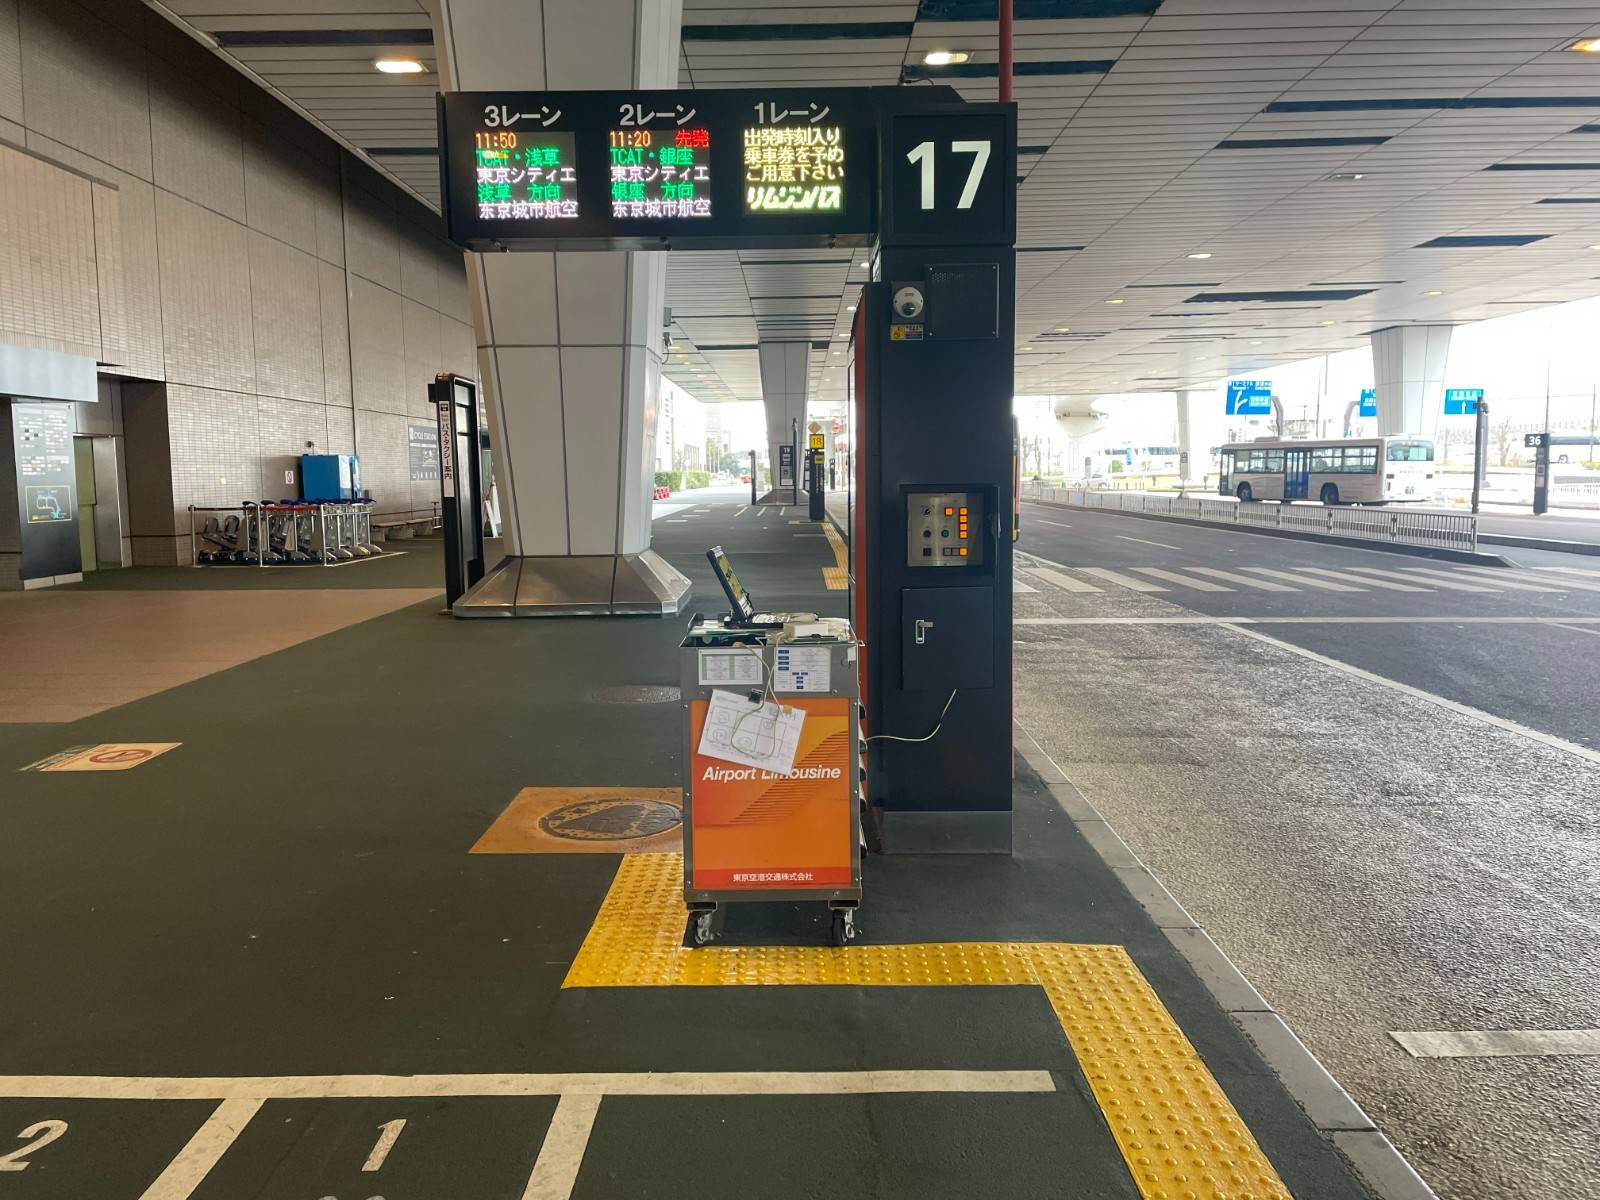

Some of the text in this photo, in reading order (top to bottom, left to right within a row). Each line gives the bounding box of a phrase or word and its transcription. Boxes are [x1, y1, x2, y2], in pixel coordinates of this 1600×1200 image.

[484, 105, 561, 127] 3レーン
[619, 104, 696, 126] 2レーン
[754, 102, 830, 124] 1レーン
[475, 132, 517, 149] 11:50
[609, 129, 709, 148] 11:20 先発
[744, 126, 840, 147] 出発時刻入り
[744, 146, 844, 164] 乗車券を予め
[746, 164, 845, 182] ご用意下さい
[906, 140, 991, 210] 17
[527, 183, 561, 202] 方向
[661, 181, 694, 200] 方向
[746, 186, 842, 210] リムジンバス
[1529, 436, 1541, 445] 36
[702, 766, 757, 784] Airport
[0, 1119, 69, 1172] 2
[361, 1118, 408, 1172] 1
